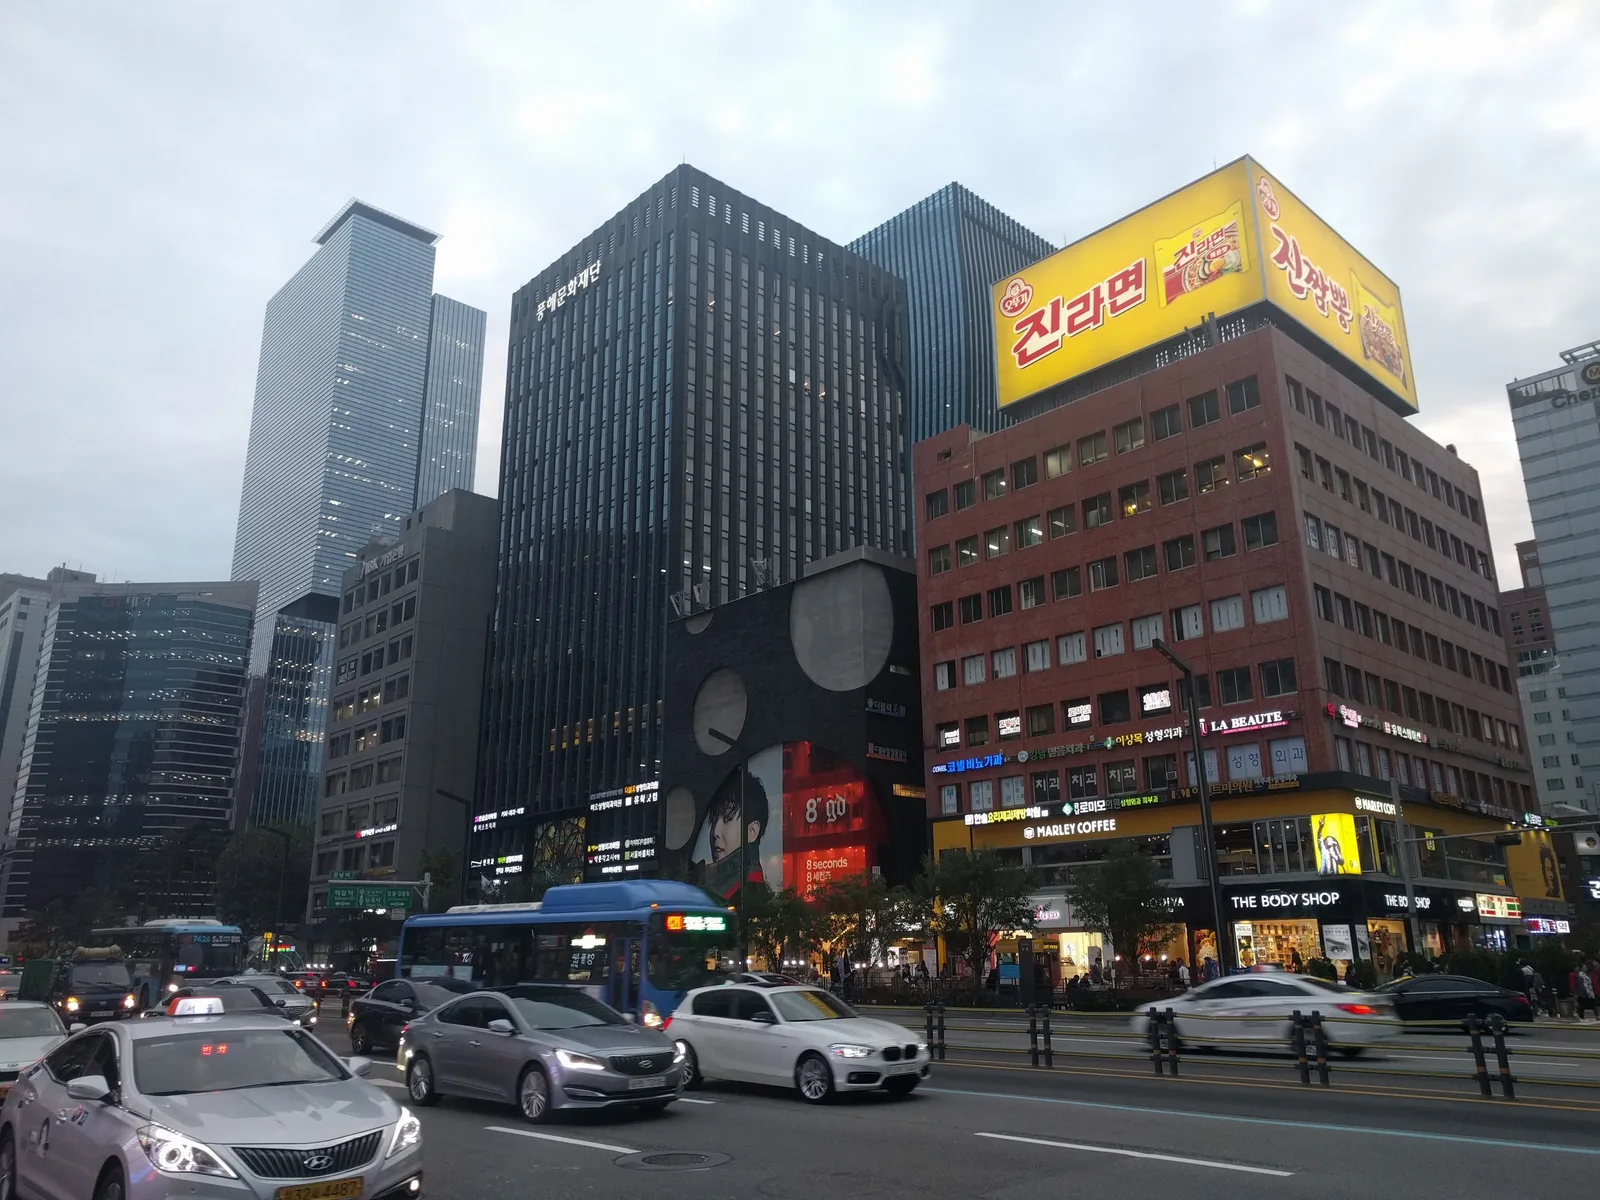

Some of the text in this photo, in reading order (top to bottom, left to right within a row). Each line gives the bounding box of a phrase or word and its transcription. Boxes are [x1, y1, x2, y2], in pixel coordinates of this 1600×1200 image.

[1173, 226, 1225, 270] 진라면
[1270, 223, 1354, 334] 진짬뽕
[536, 259, 601, 322] 풍해문화재단
[1004, 292, 1028, 312] 오뚜기
[1013, 256, 1147, 368] 진라면
[380, 544, 404, 567] 기업은행
[1211, 720, 1229, 731] LA
[1231, 711, 1282, 728] BEAUTE
[1115, 726, 1183, 747] 이상목 성형외과
[1232, 747, 1304, 769] 성형 외과
[1071, 772, 1097, 788] 치과
[1108, 766, 1136, 783] 치과
[1035, 777, 1060, 792] 치과
[826, 792, 846, 823] gd
[1362, 798, 1384, 813] MARLEY
[1037, 818, 1116, 838] MARLEY COFFEE
[806, 857, 848, 870] 8 seconds
[813, 871, 831, 882] 세컨즈
[1141, 896, 1185, 908] ODIVA
[1232, 892, 1341, 908] THE BODY SHOP
[1384, 894, 1398, 907] THE
[1415, 896, 1431, 909] SHOP
[186, 1003, 215, 1014] 서울
[201, 1044, 228, 1056] 빈차
[322, 1180, 357, 1197] 4487
